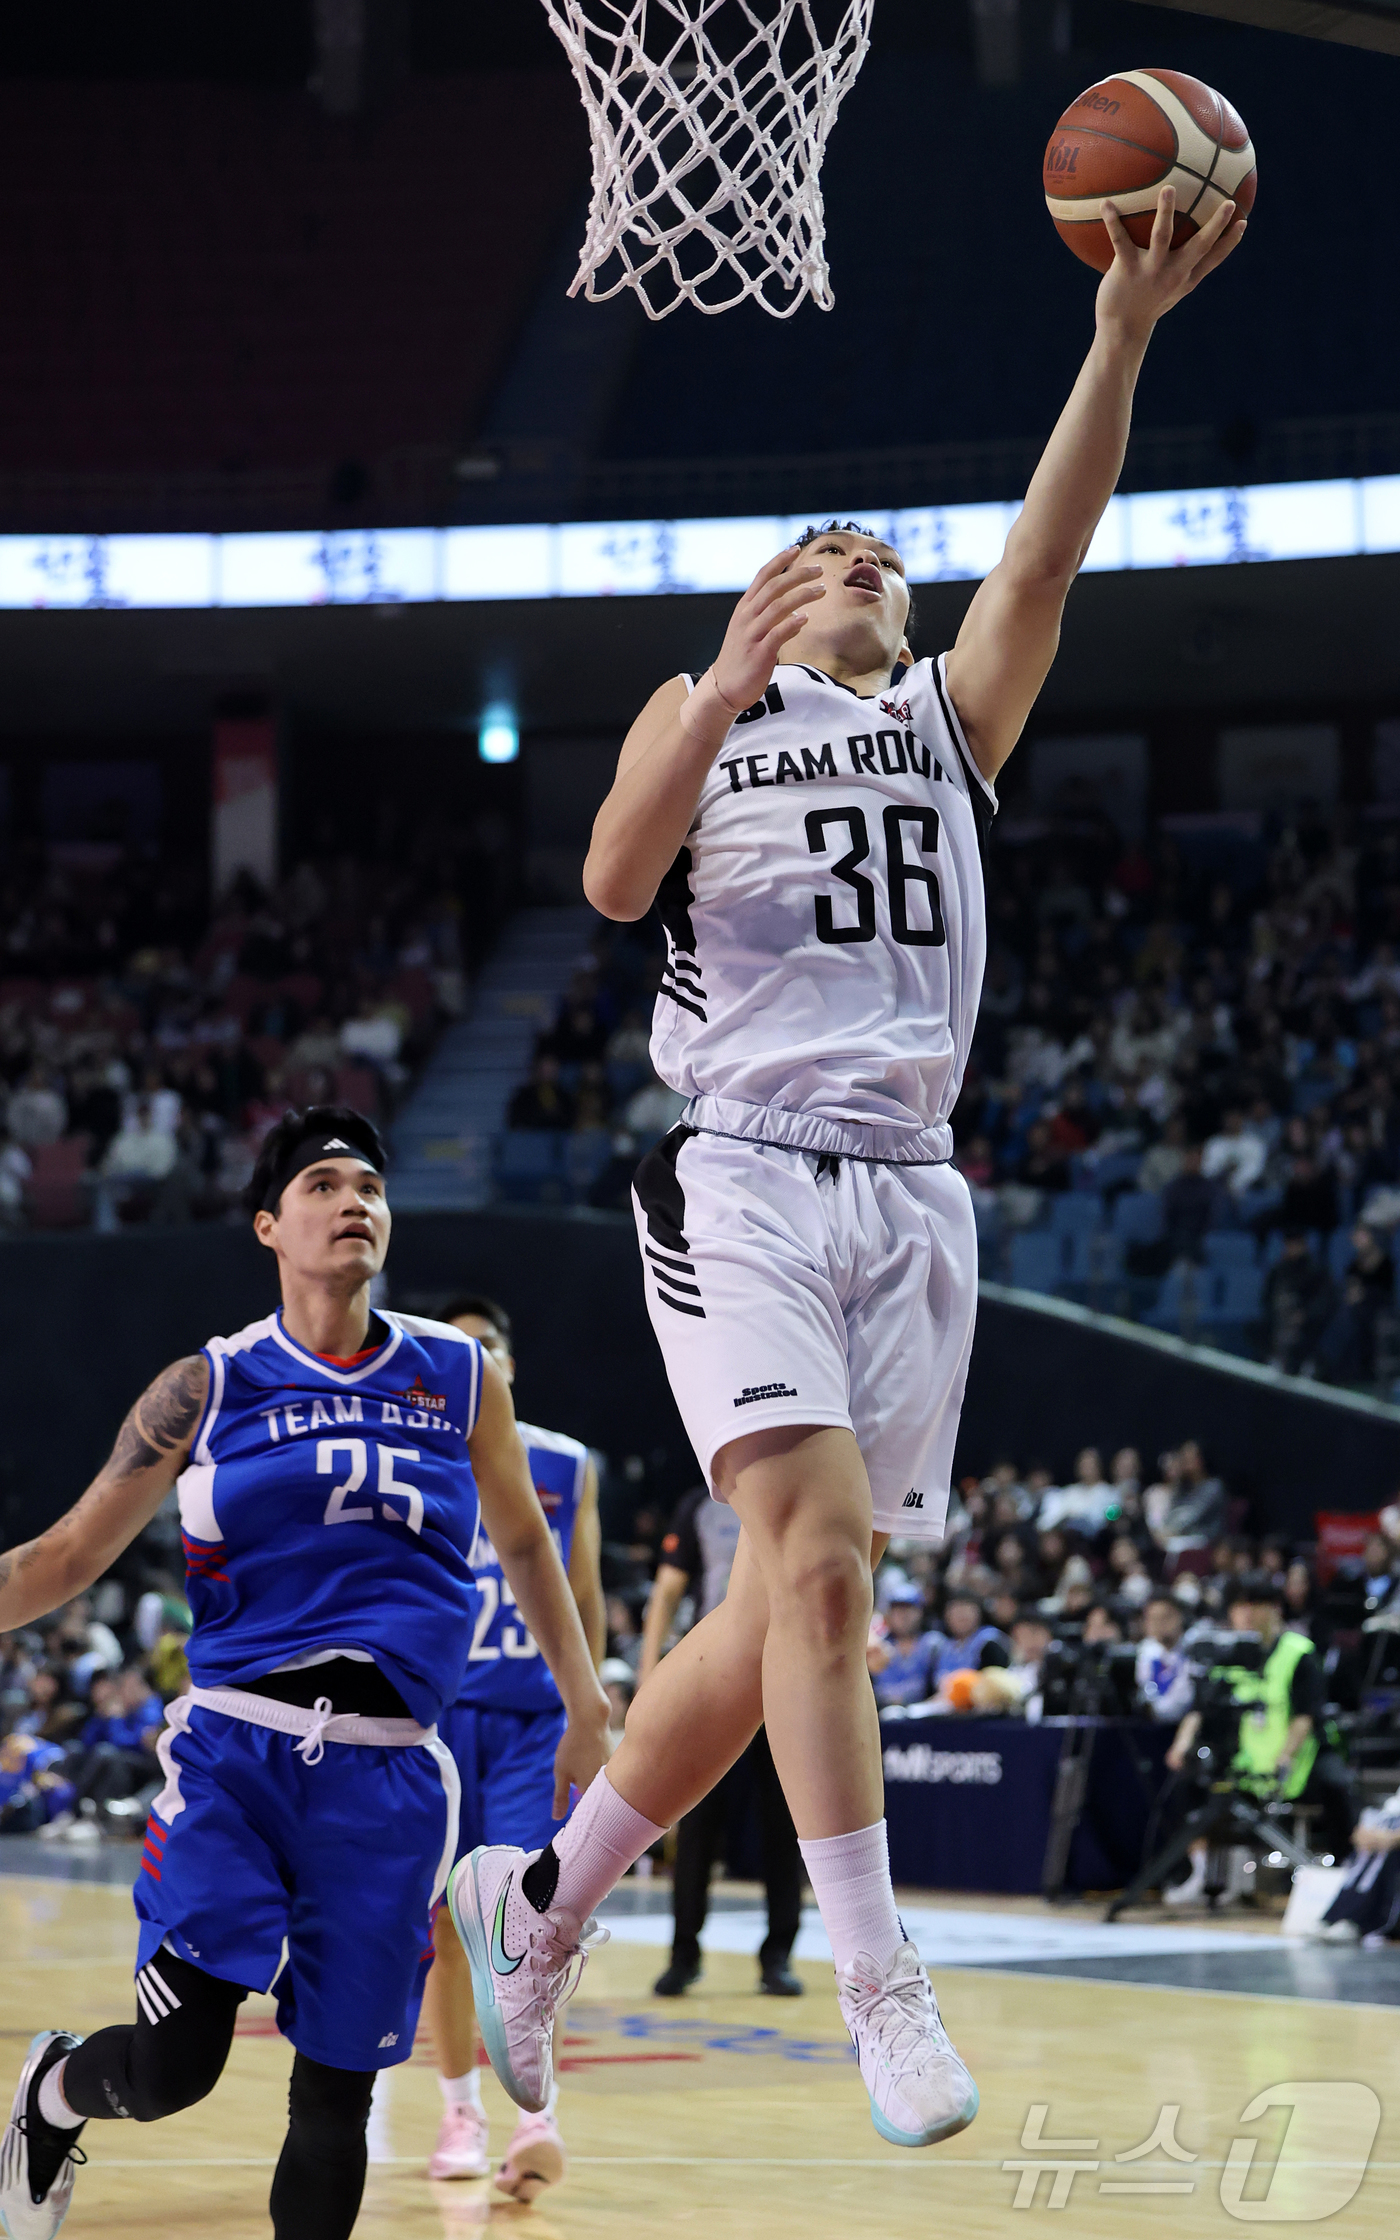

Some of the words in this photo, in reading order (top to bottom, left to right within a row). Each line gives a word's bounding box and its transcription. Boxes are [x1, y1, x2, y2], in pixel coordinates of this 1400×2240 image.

[719, 742, 838, 794] TEAM
[804, 805, 946, 947] 36
[733, 1388, 798, 1408] Illustrated
[741, 1382, 787, 1397] Sports
[259, 1395, 364, 1443] TEAM
[315, 1437, 425, 1537] 25
